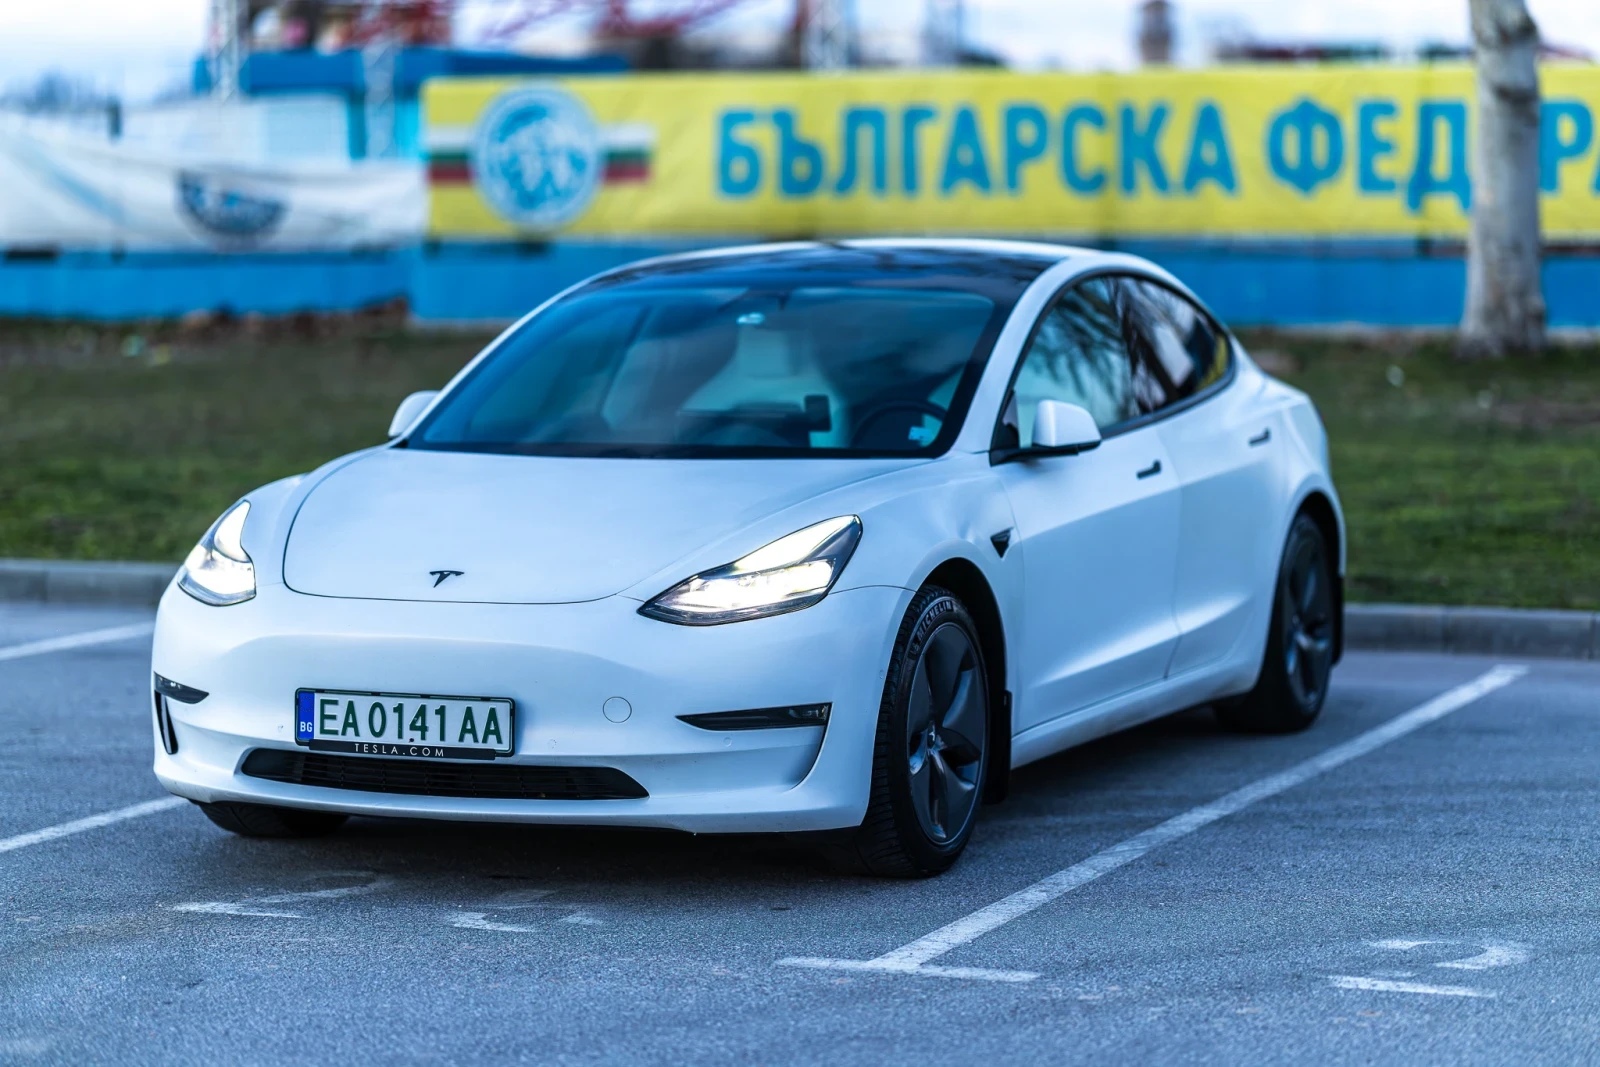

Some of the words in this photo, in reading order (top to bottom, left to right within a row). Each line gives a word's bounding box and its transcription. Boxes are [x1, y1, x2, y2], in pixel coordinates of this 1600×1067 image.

[715, 102, 1239, 200] БЪЛГАРСКА
[1266, 99, 1600, 213] ФЕДР
[916, 600, 954, 641] MICHELIN
[299, 721, 313, 733] BG
[354, 743, 445, 758] TESLA.COM
